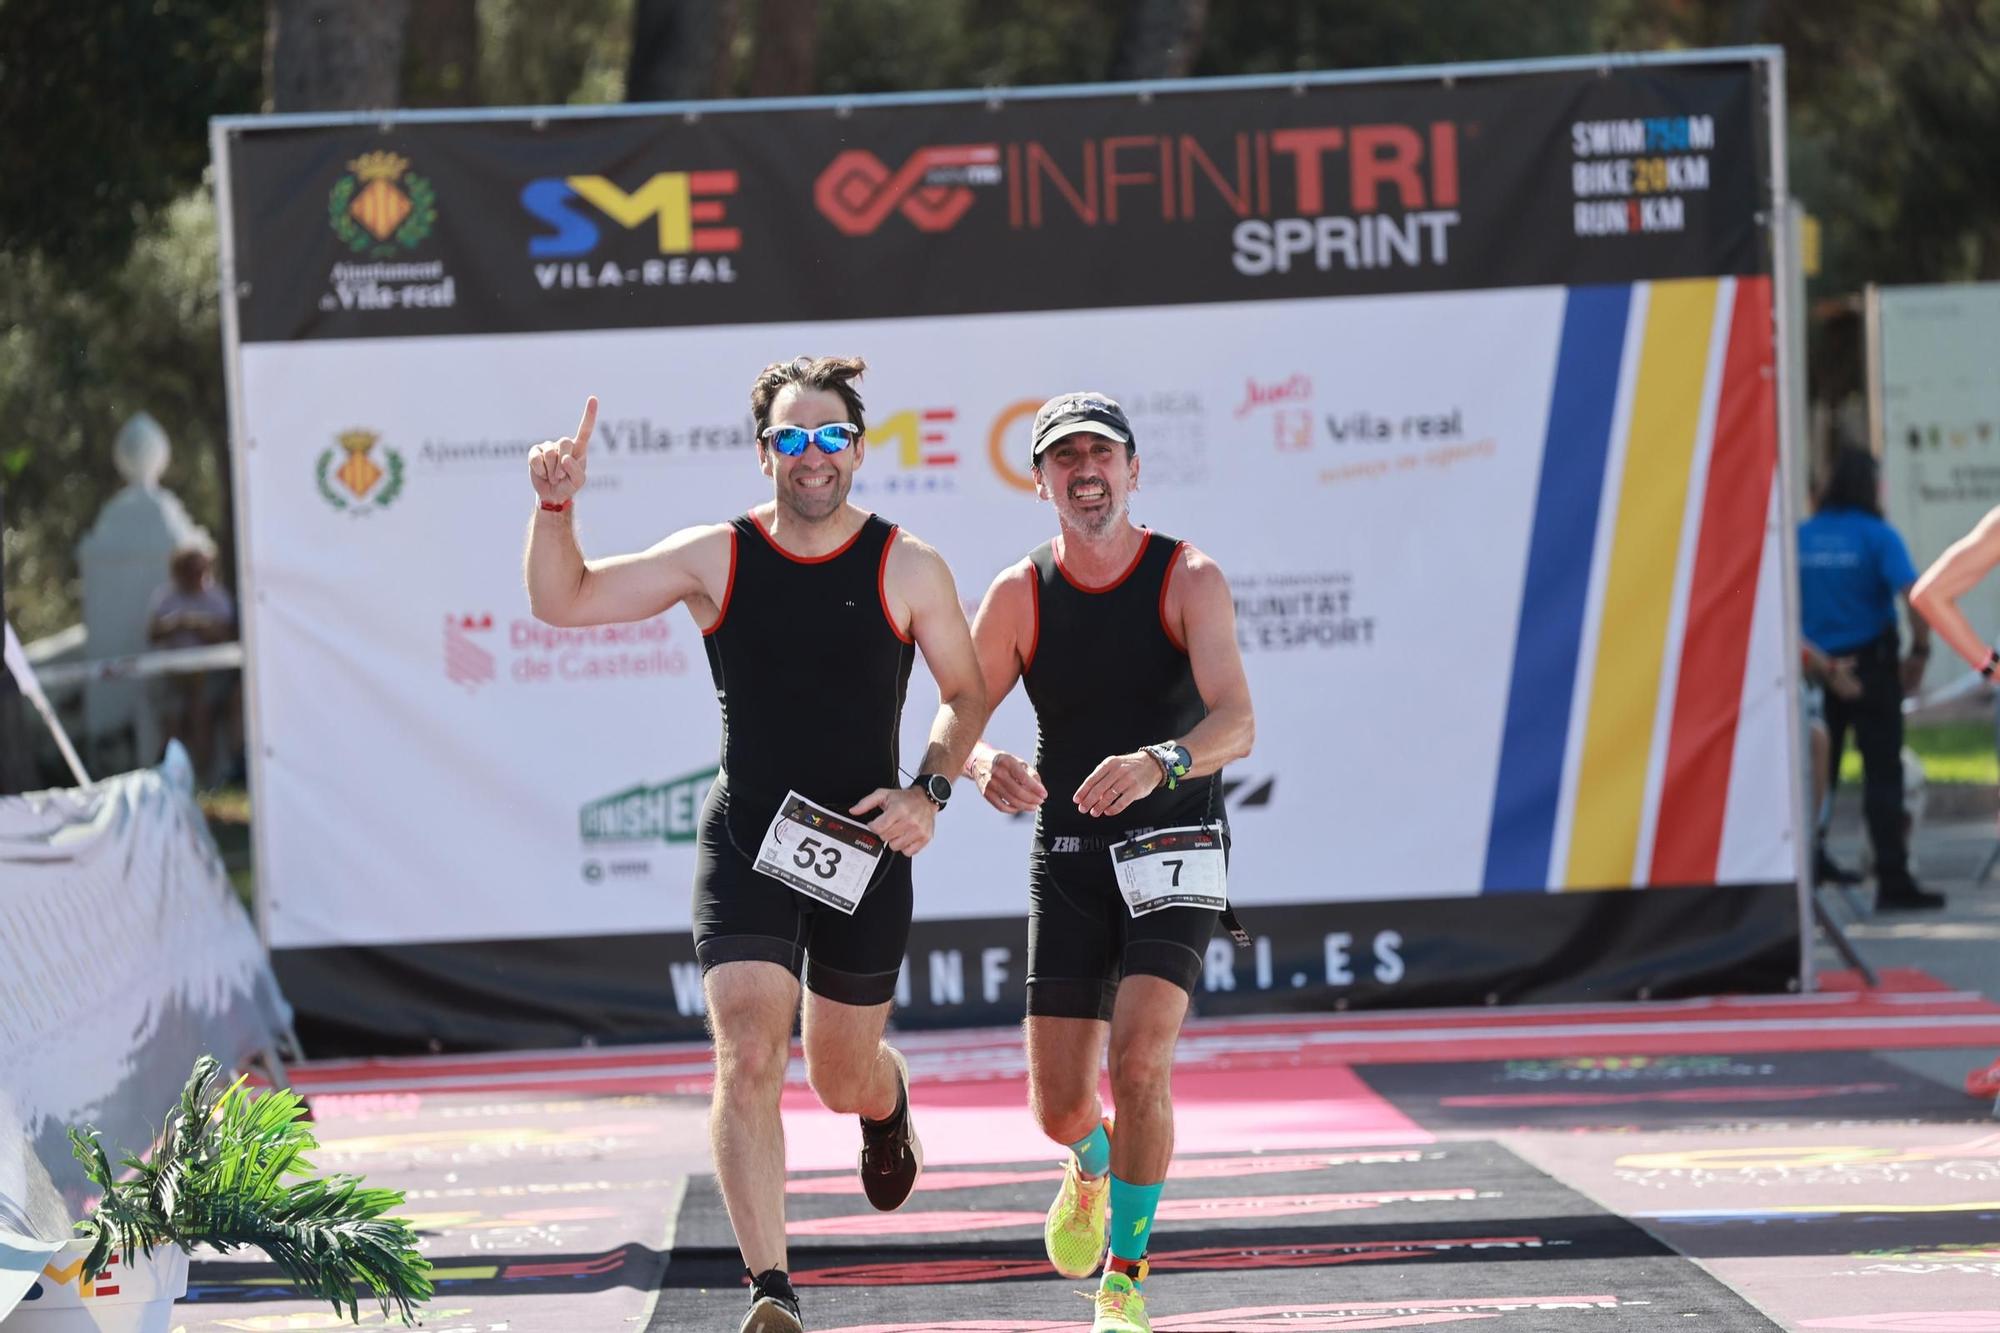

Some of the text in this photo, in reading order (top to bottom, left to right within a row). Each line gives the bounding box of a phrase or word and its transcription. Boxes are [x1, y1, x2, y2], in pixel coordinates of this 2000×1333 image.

[1007, 121, 1460, 229] INFINITRI
[522, 169, 742, 257] SME
[1233, 211, 1460, 275] SPRINT
[535, 257, 737, 290] VILA-REAL
[419, 436, 530, 462] Ajuntam
[865, 409, 959, 470] ME
[793, 836, 842, 879] 53
[1162, 859, 1184, 887] 7
